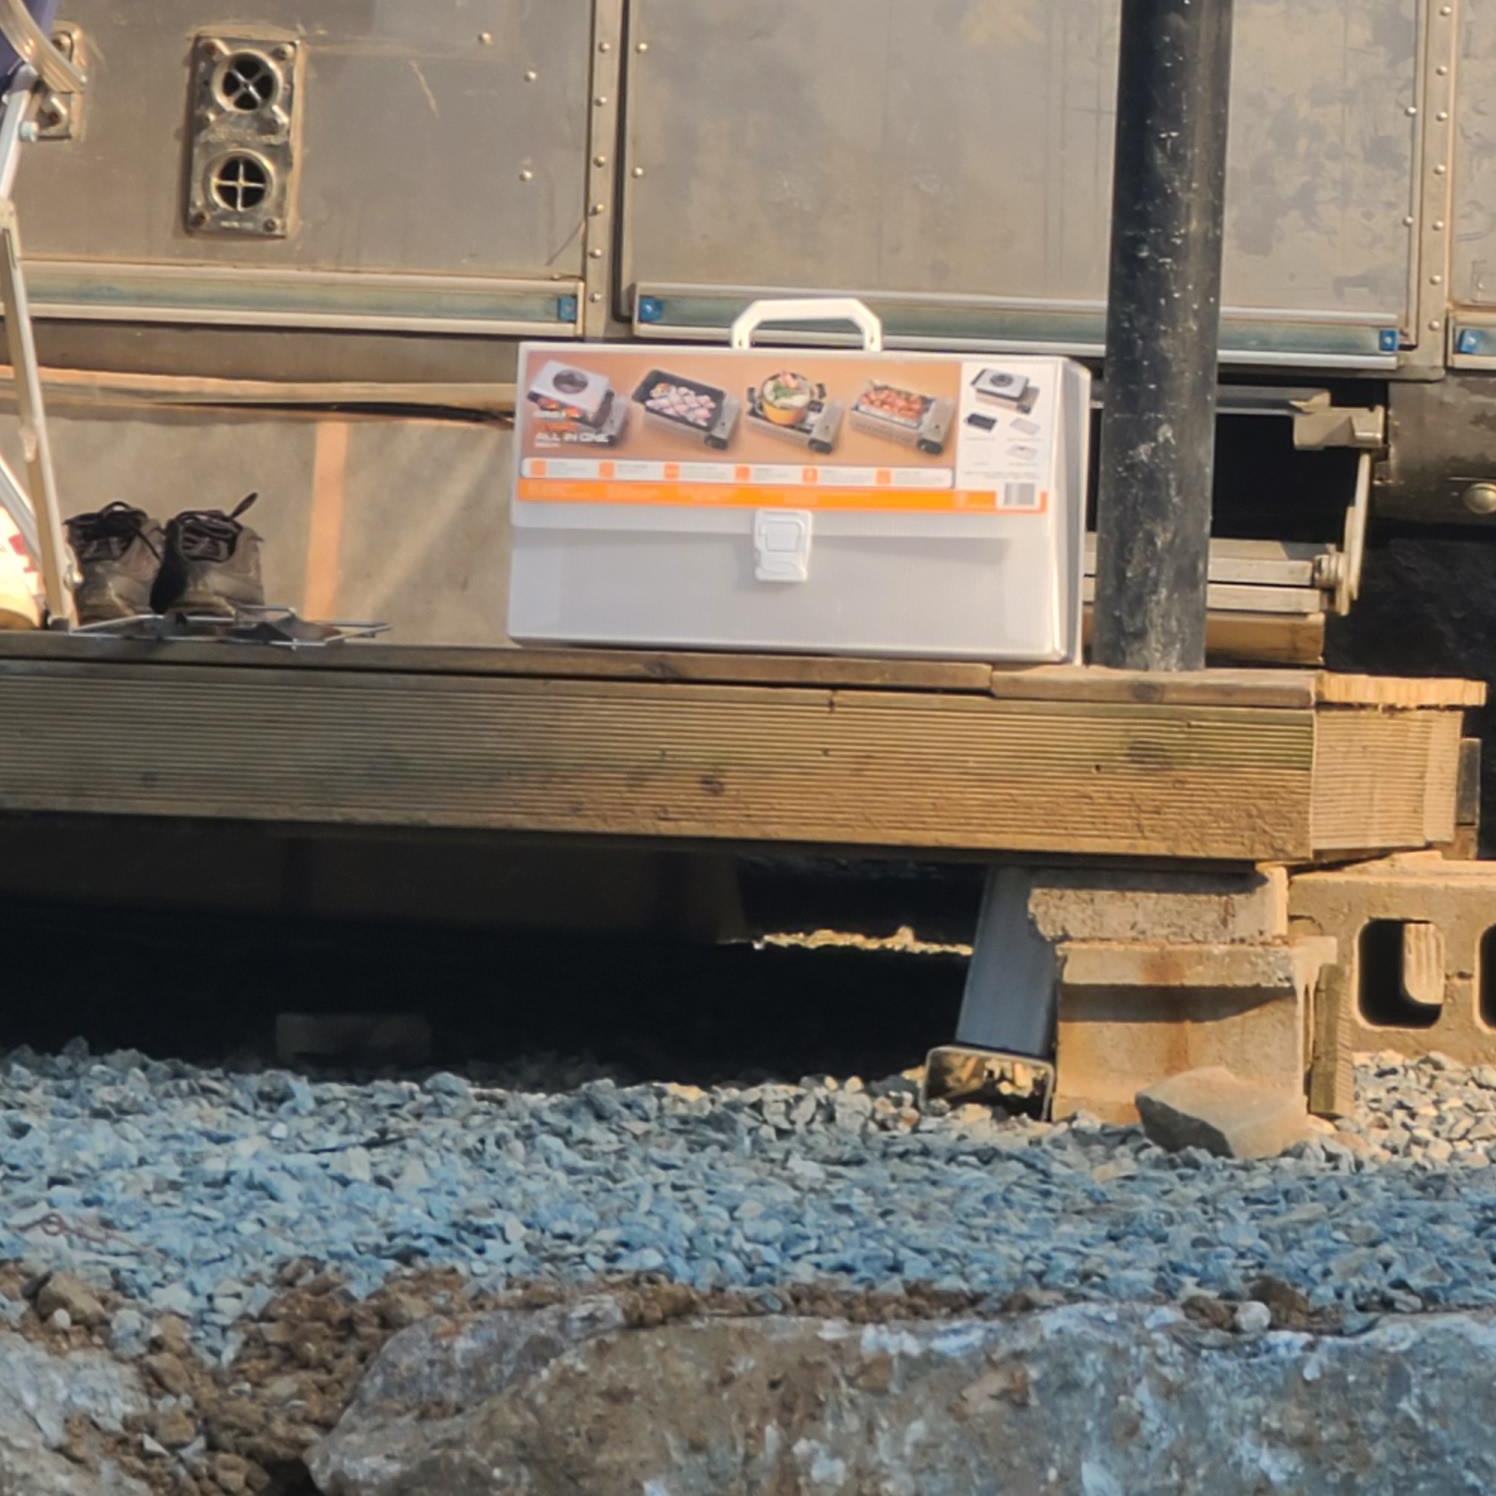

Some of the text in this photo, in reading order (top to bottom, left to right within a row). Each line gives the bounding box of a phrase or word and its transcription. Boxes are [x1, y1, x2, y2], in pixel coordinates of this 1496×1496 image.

[535, 431, 609, 443] ALL IN ONE
